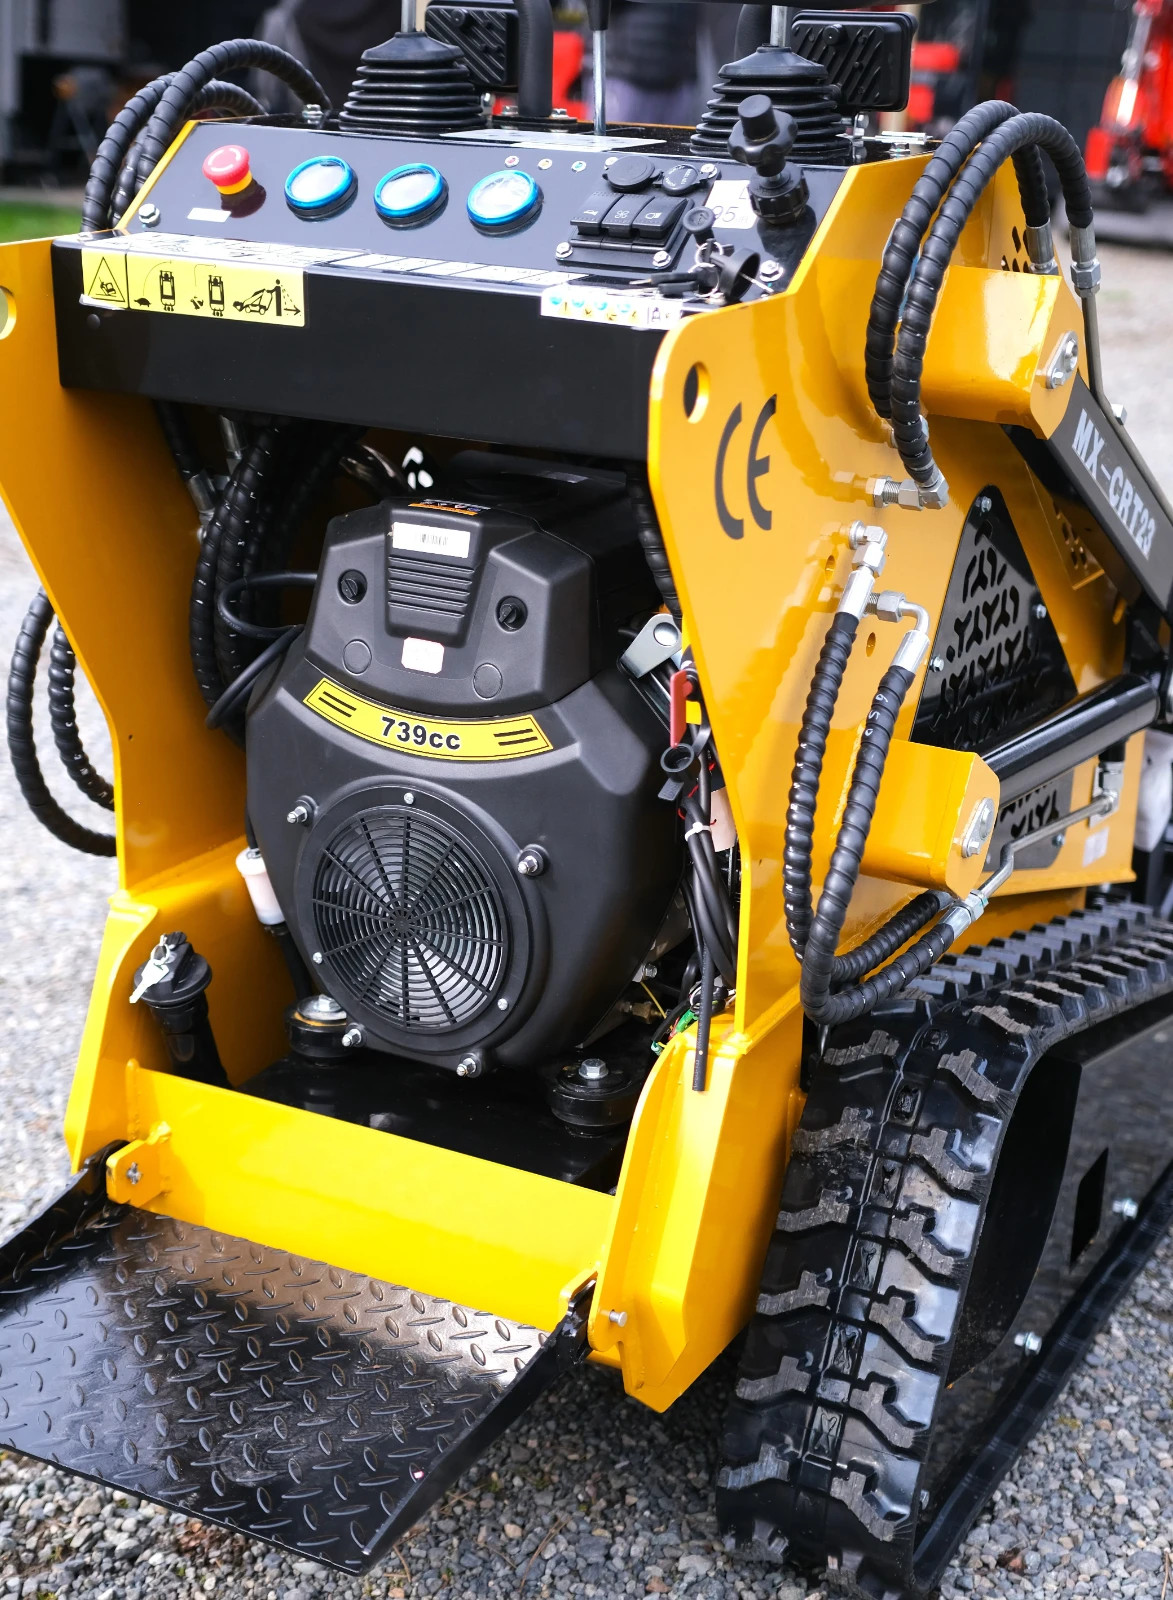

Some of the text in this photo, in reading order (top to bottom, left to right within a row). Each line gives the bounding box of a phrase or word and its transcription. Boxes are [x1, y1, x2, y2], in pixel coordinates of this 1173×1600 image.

[714, 393, 777, 541] CE
[1071, 408, 1156, 560] MX-CRT23
[381, 716, 461, 750] 739cc
